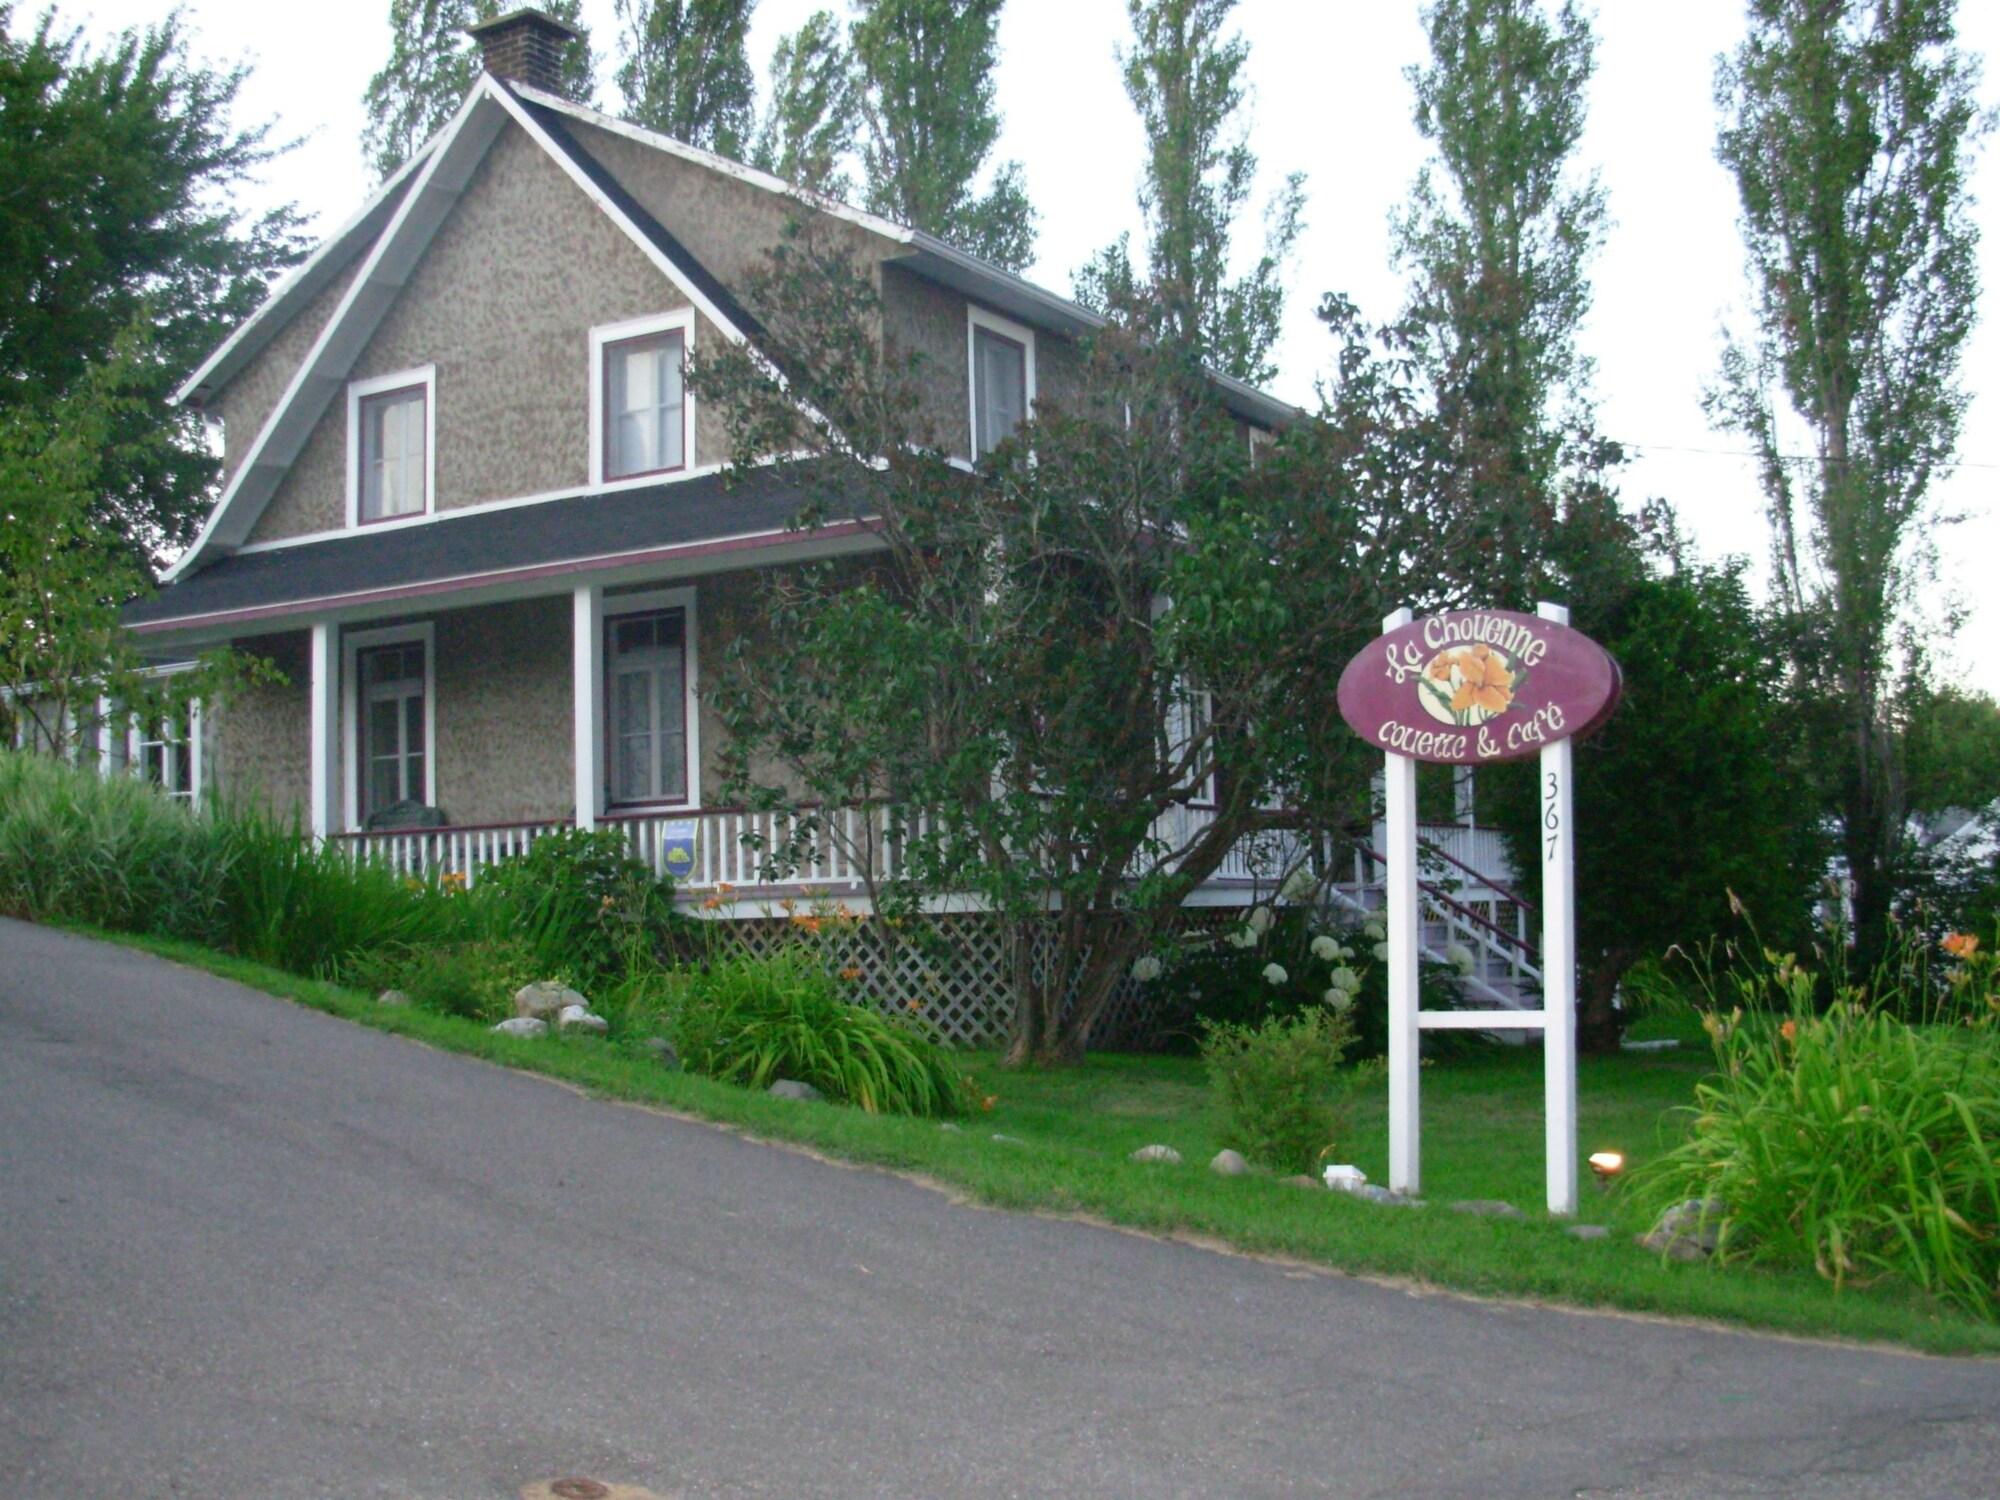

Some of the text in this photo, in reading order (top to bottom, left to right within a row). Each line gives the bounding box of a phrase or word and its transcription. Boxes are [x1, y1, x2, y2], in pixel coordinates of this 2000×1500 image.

[1385, 614, 1547, 684] La Chouenne
[1477, 726, 1501, 758] &
[1544, 772, 1559, 862] 367
